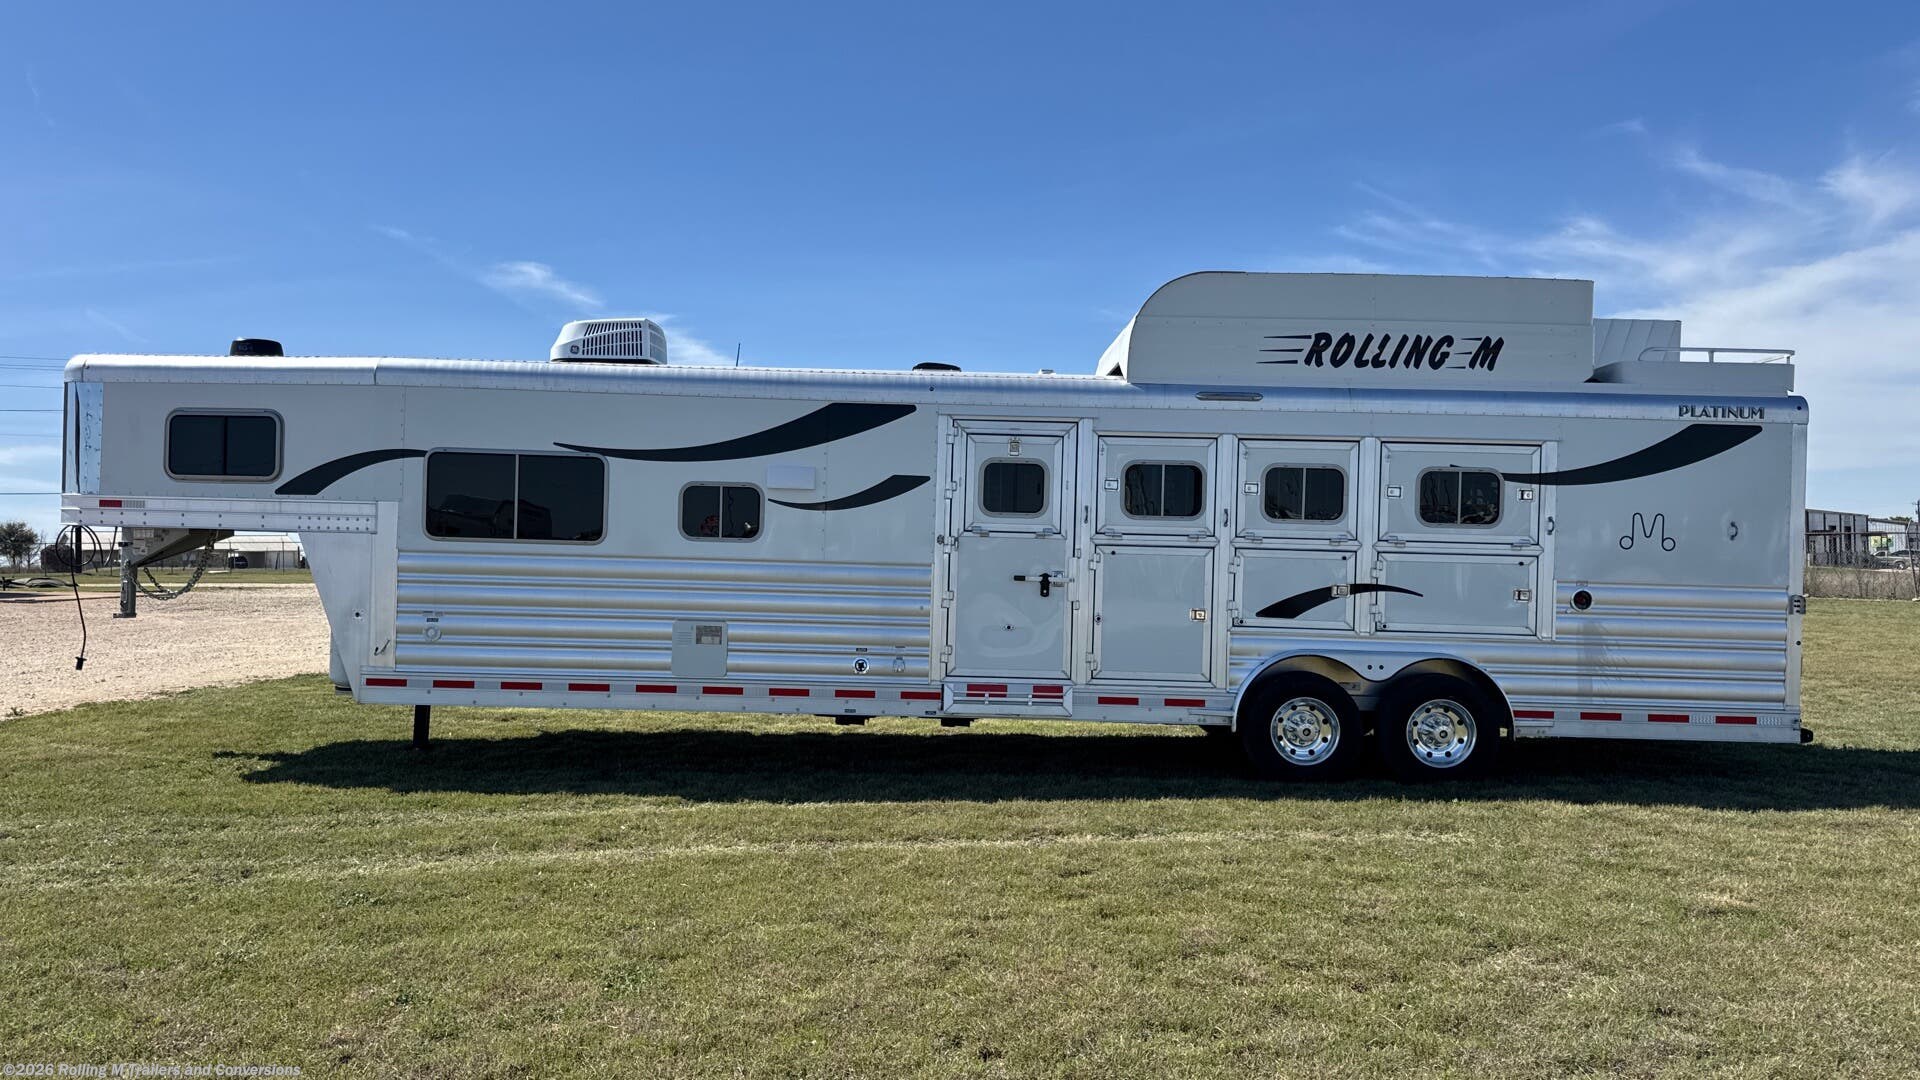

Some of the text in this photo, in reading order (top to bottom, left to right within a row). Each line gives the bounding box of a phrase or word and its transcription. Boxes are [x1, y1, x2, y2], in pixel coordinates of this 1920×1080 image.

[1303, 332, 1505, 371] ROLLING M
[1678, 404, 1765, 419] PLATINUM
